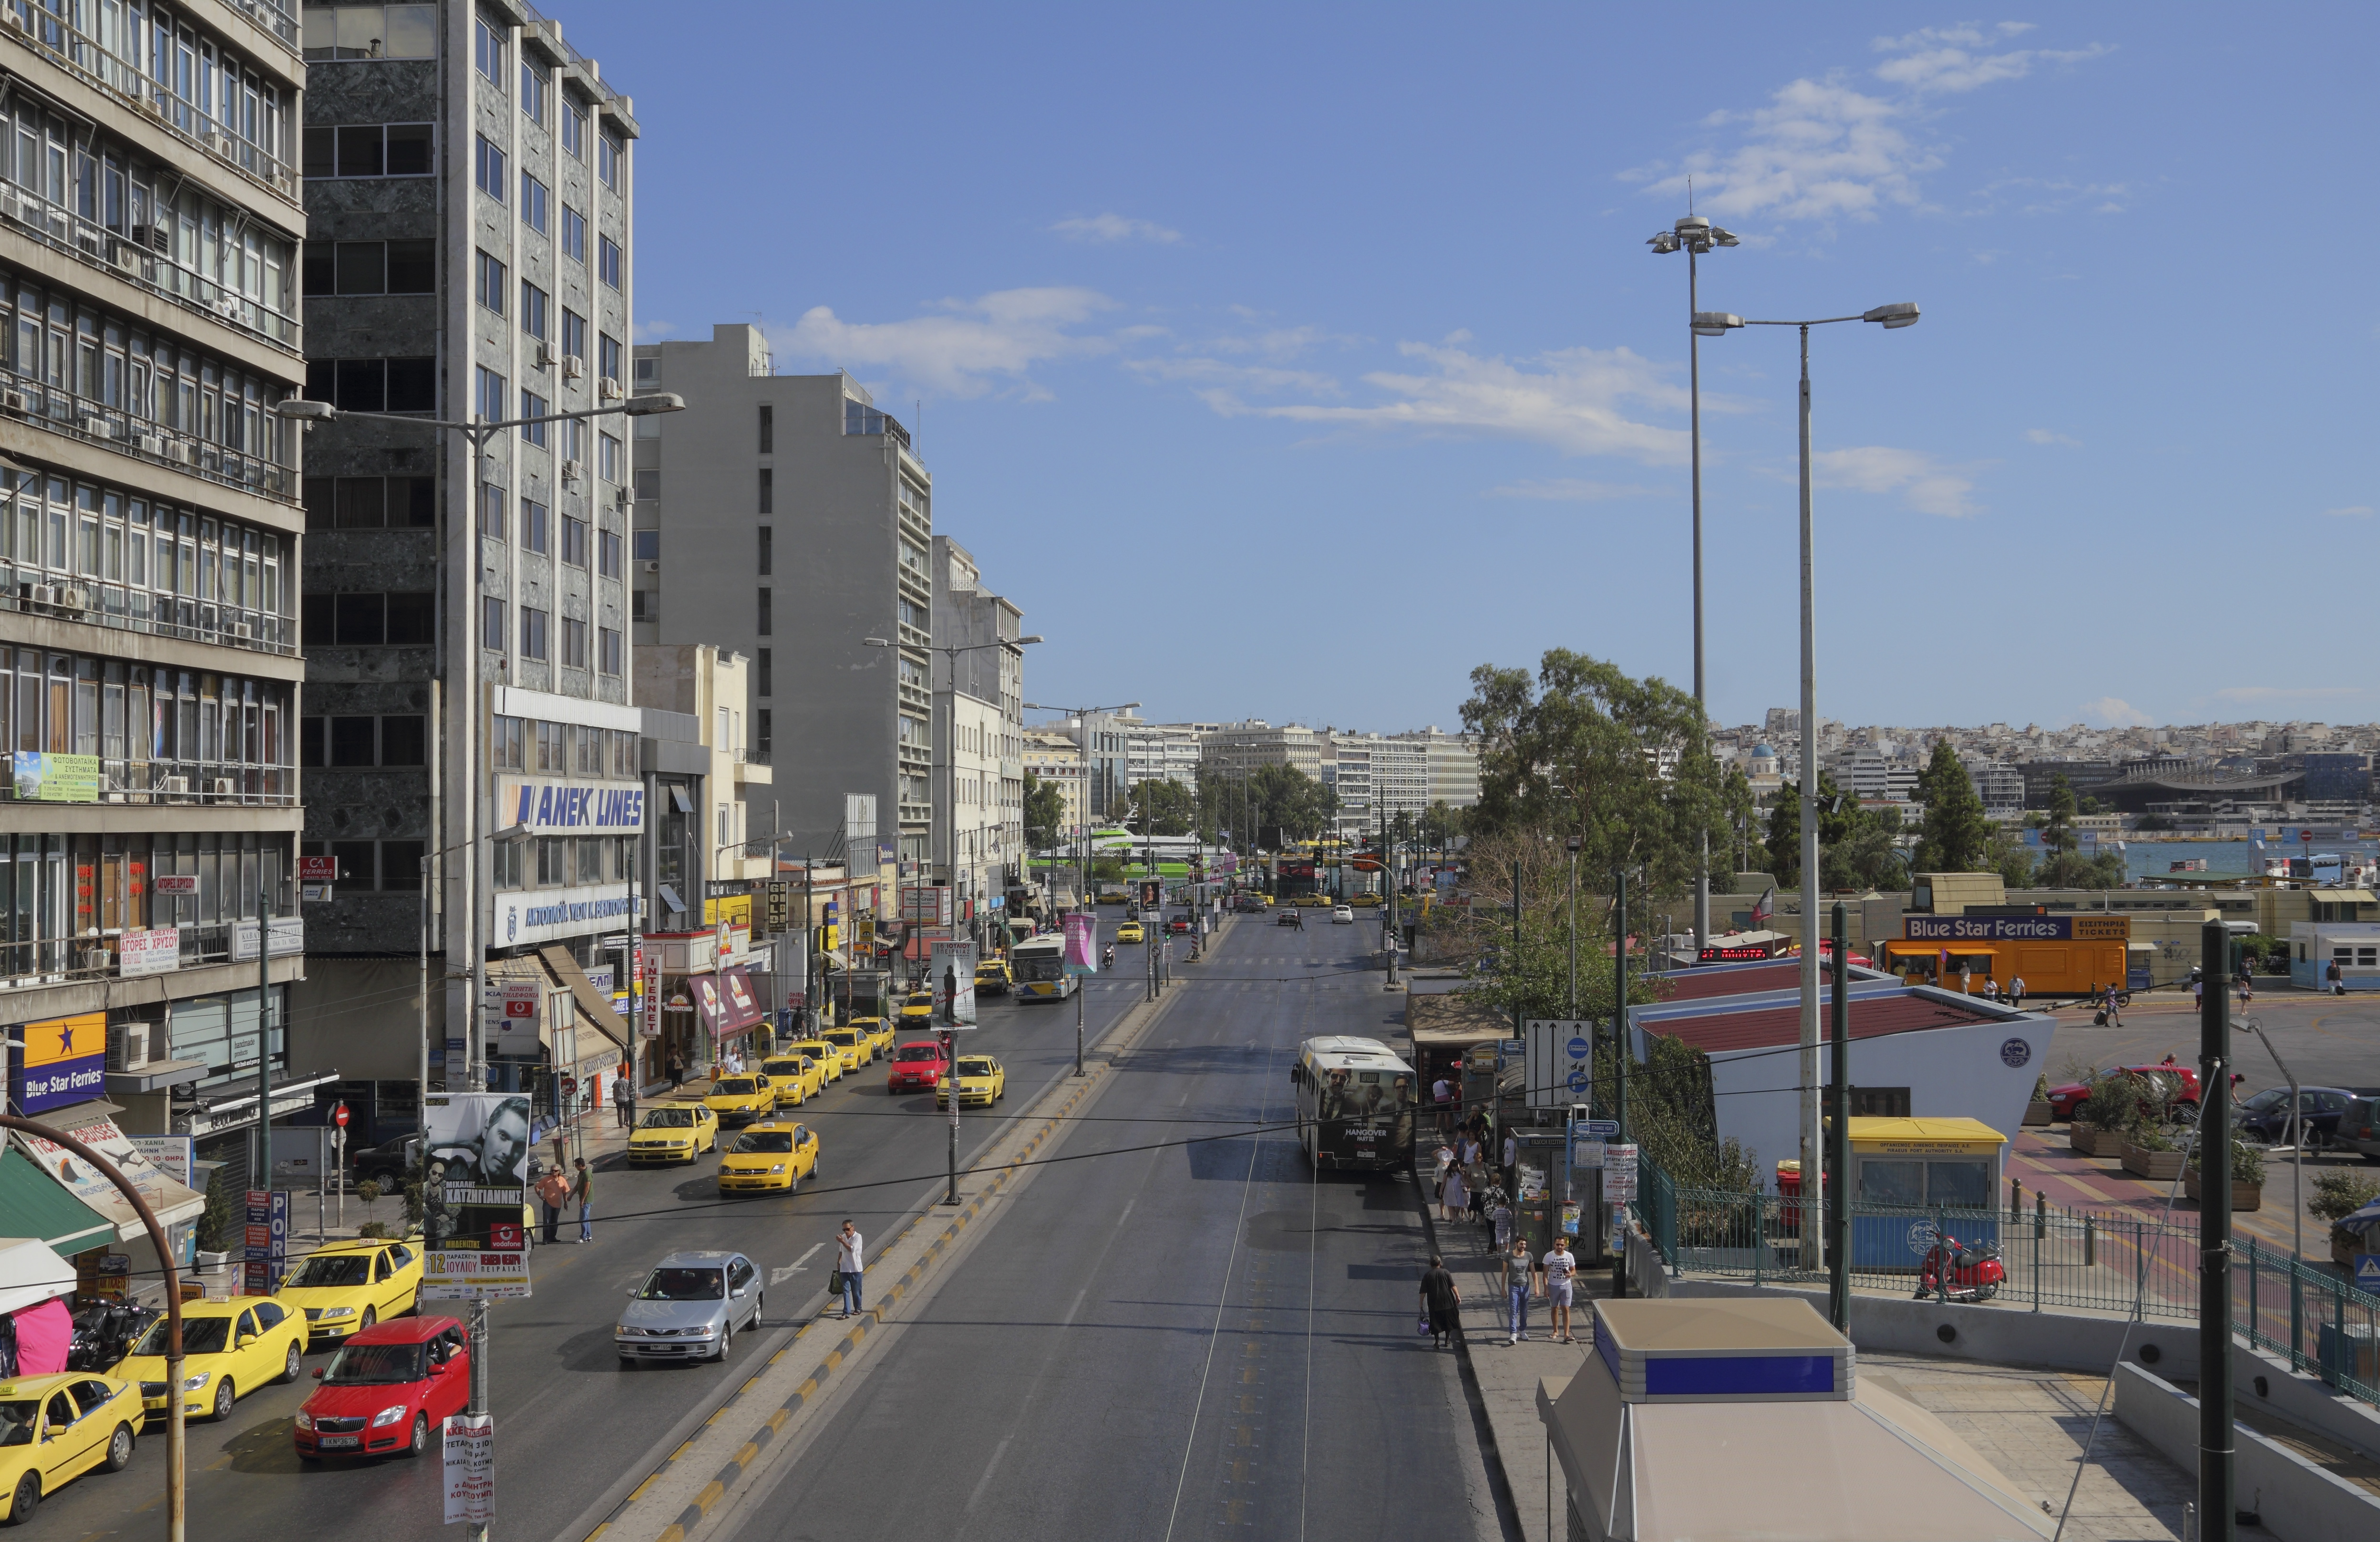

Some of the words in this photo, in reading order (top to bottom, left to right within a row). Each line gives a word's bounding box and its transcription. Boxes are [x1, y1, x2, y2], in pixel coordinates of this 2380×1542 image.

[536, 787, 594, 827] ANEK
[596, 790, 644, 827] LINES
[158, 878, 176, 889] ΑΓΟΡΕΣ
[177, 878, 195, 889] ΧΡΥΣΟΥ
[727, 883, 744, 895] change
[770, 884, 779, 923] GOLD
[121, 931, 144, 940] ΔΑΝΕΙΑ
[151, 929, 177, 937] ΕΝΕΧΥΡΑ
[281, 927, 301, 936] TRAVEL
[1911, 921, 1950, 936] Blue
[1955, 920, 1991, 936] Star
[1996, 919, 2058, 936] Ferries
[121, 938, 147, 952] ΑΓΟΡΕΣ
[153, 935, 178, 950] ΧΡΥΣΟΥ
[648, 959, 657, 1031] INTERNET
[583, 1052, 618, 1074] ΜΠΟΥΡΟΥΤΗΣ
[26, 1080, 48, 1098] Blue
[51, 1076, 69, 1092] Star
[71, 1068, 101, 1088] Ferries
[446, 1189, 522, 1204] ΧΑΤΖΗΓΙΑΝΝΗΣ
[445, 1240, 480, 1249] ΜΗΔΕΝΙΣΤΗΣ
[430, 1253, 445, 1273] 12
[447, 1261, 477, 1273] ΙΟΥΛΙΟΥ
[446, 1426, 464, 1437] ΚΚΕ
[451, 1490, 494, 1500] ΚΟΥΤΣΟΥΜΠ
